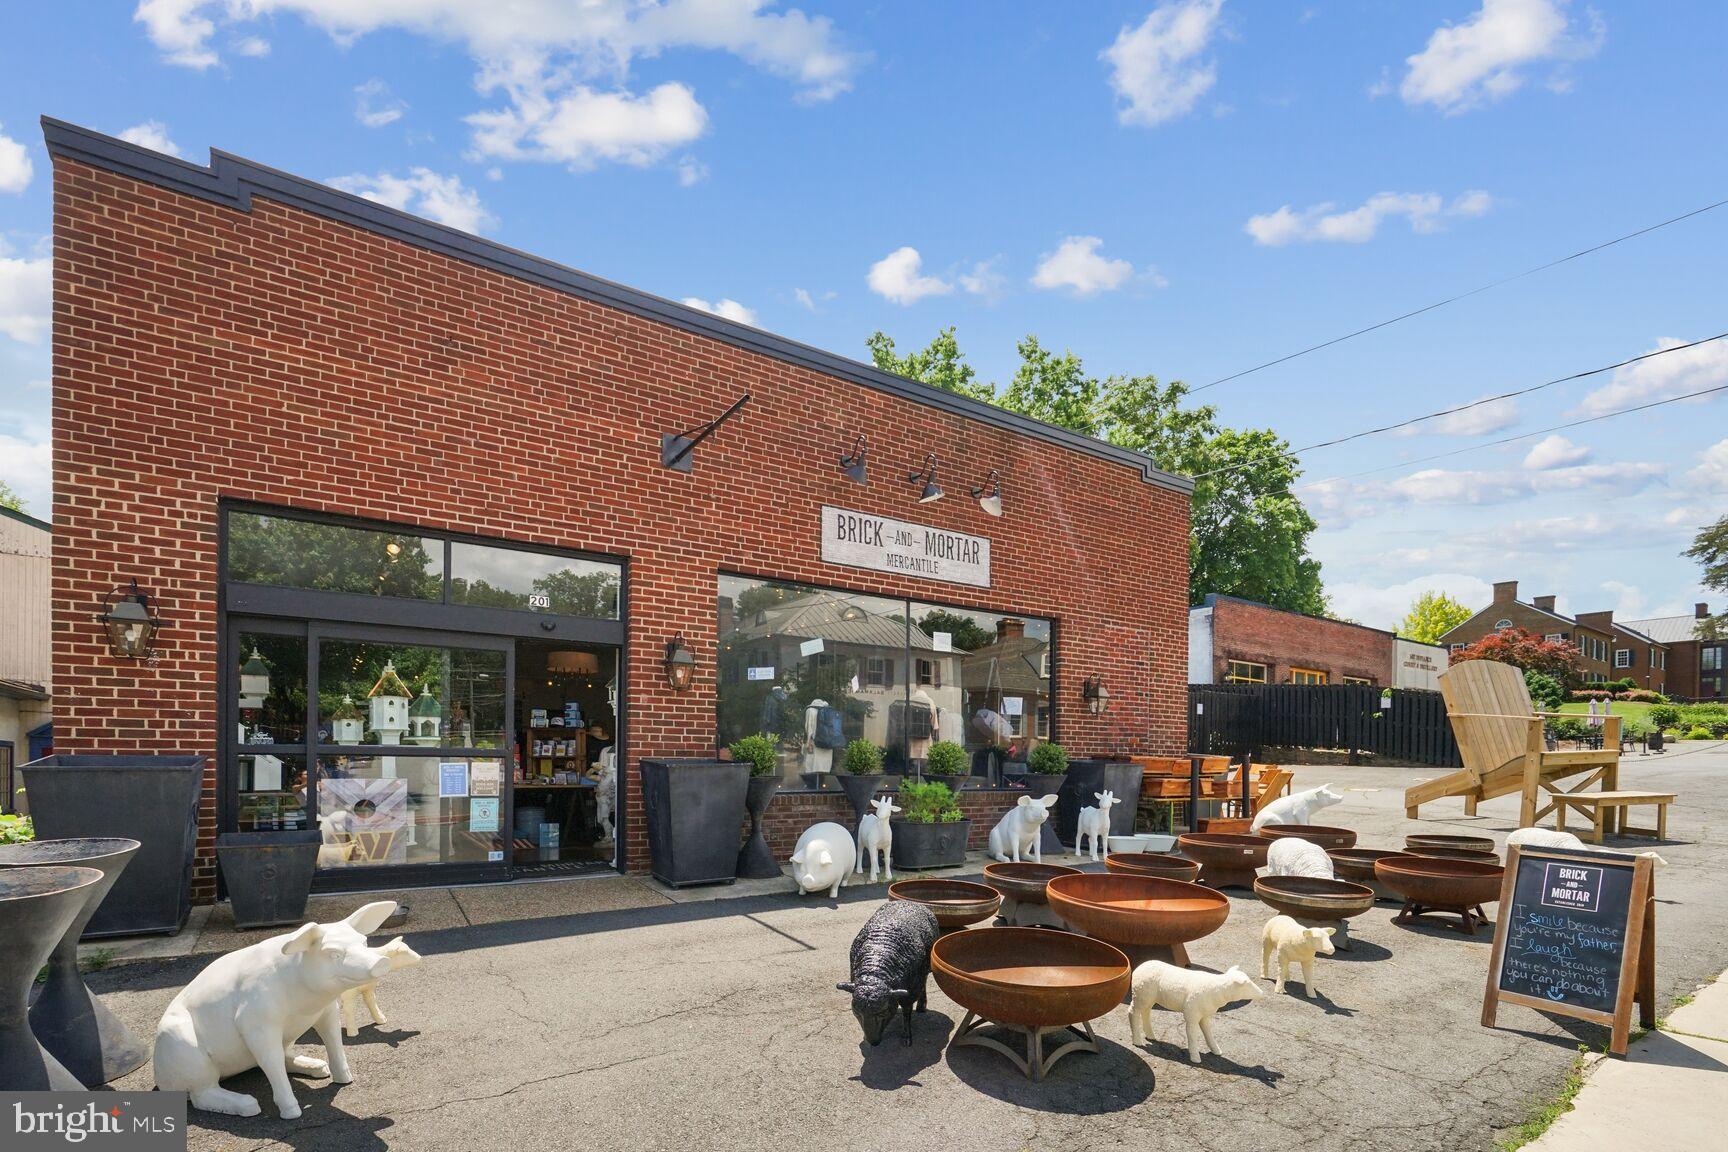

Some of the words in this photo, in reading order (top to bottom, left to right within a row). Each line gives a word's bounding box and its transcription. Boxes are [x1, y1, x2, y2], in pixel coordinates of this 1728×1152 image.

[837, 514, 884, 547] BRICK
[925, 531, 980, 565] MORTAR
[886, 553, 939, 575] MERCANTILE
[531, 596, 549, 607] 201
[1559, 868, 1588, 881] BRICK
[1551, 887, 1591, 902] MORTAR
[1514, 903, 1527, 919] I
[1529, 912, 1564, 928] smile
[1567, 917, 1619, 937] because
[1513, 923, 1552, 938] you're
[1555, 931, 1575, 946] my
[1510, 937, 1524, 949] I
[1526, 939, 1573, 963] laugh
[1560, 959, 1607, 975] because
[1506, 968, 1528, 984] you
[1531, 973, 1553, 985] can
[1556, 978, 1570, 990] do
[1571, 983, 1610, 998] about
[1509, 957, 1548, 974] there's
[1552, 969, 1605, 989] nothing
